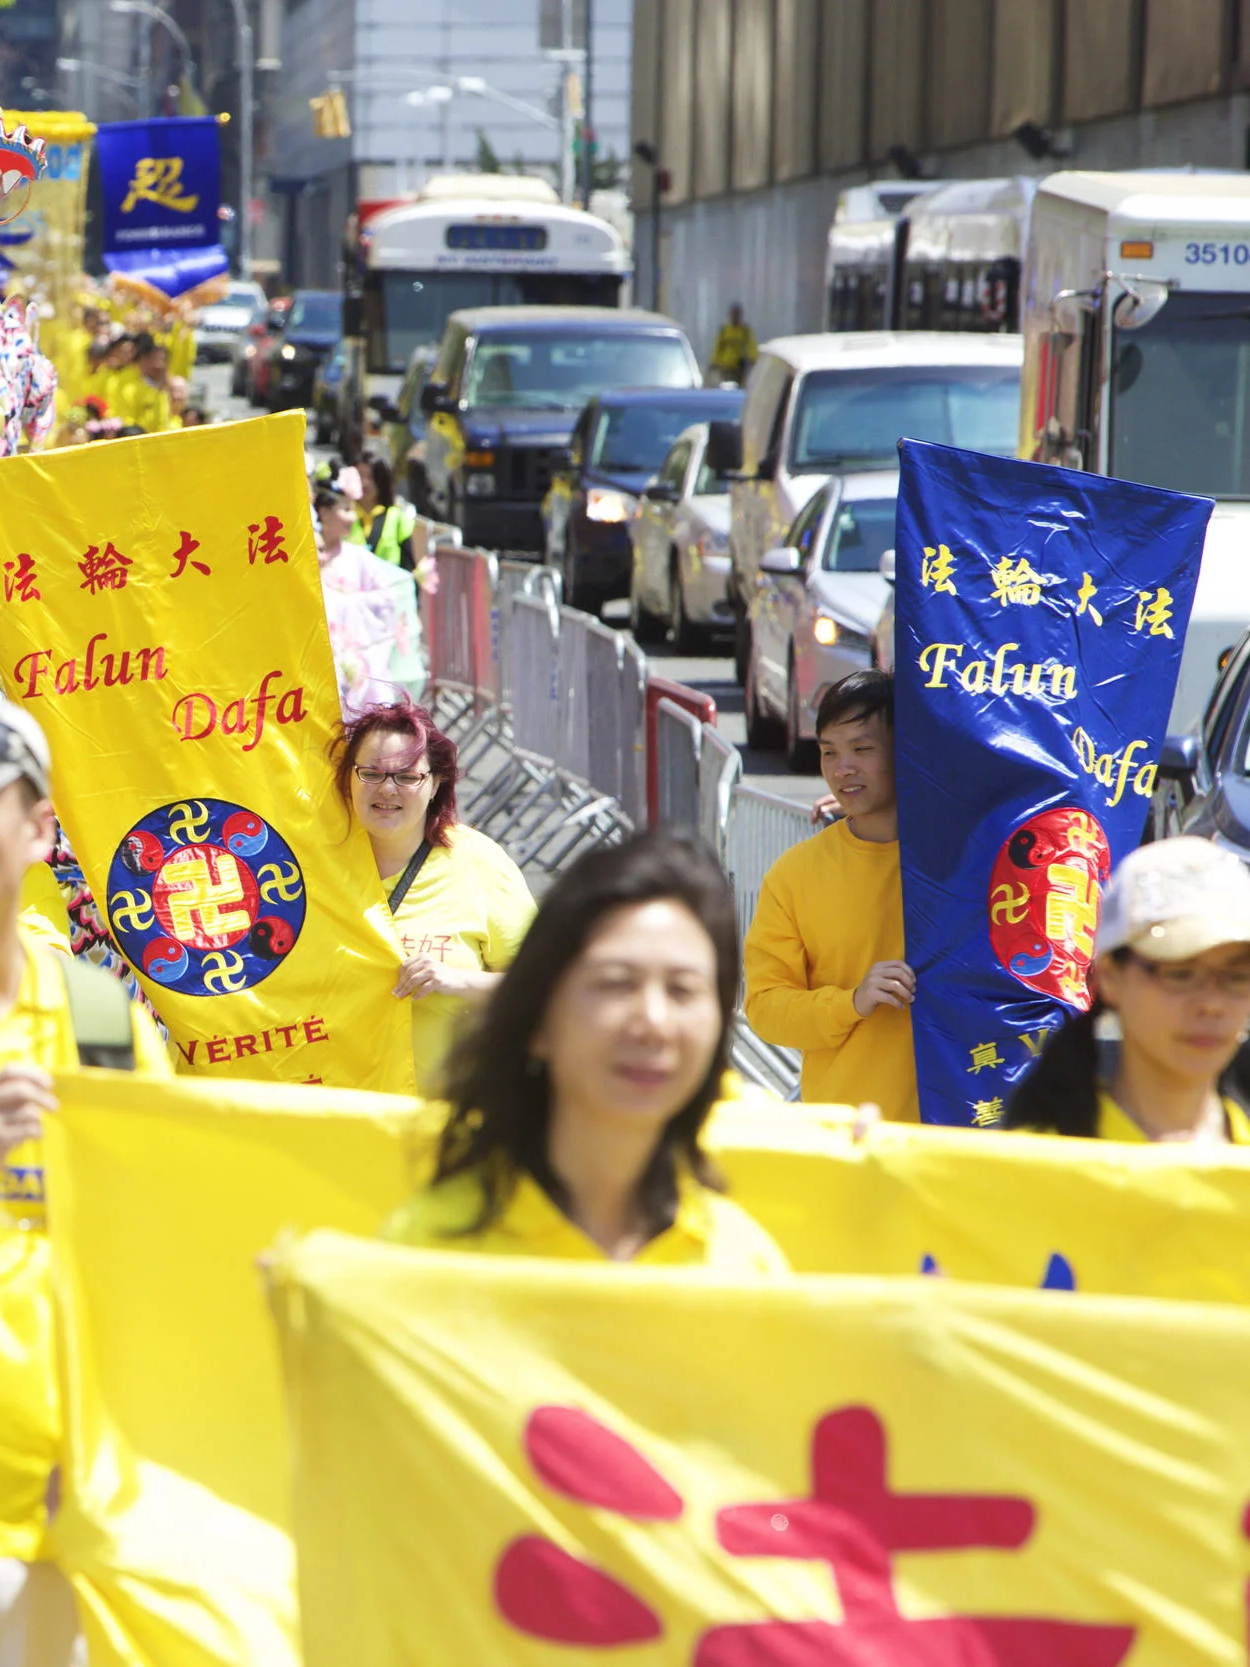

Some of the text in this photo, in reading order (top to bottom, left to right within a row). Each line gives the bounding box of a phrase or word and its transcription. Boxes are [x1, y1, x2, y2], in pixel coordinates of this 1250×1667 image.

[1184, 242, 1250, 265] 3510
[3, 515, 289, 602] 法輪大法
[921, 543, 1174, 640] 法輪大法
[13, 633, 169, 699] Falun
[918, 642, 1078, 699] Falun
[172, 670, 308, 752] Dafa
[1072, 726, 1159, 807] Dafa
[176, 1014, 329, 1066] VÉRITÉ
[966, 1041, 1006, 1075] 真
